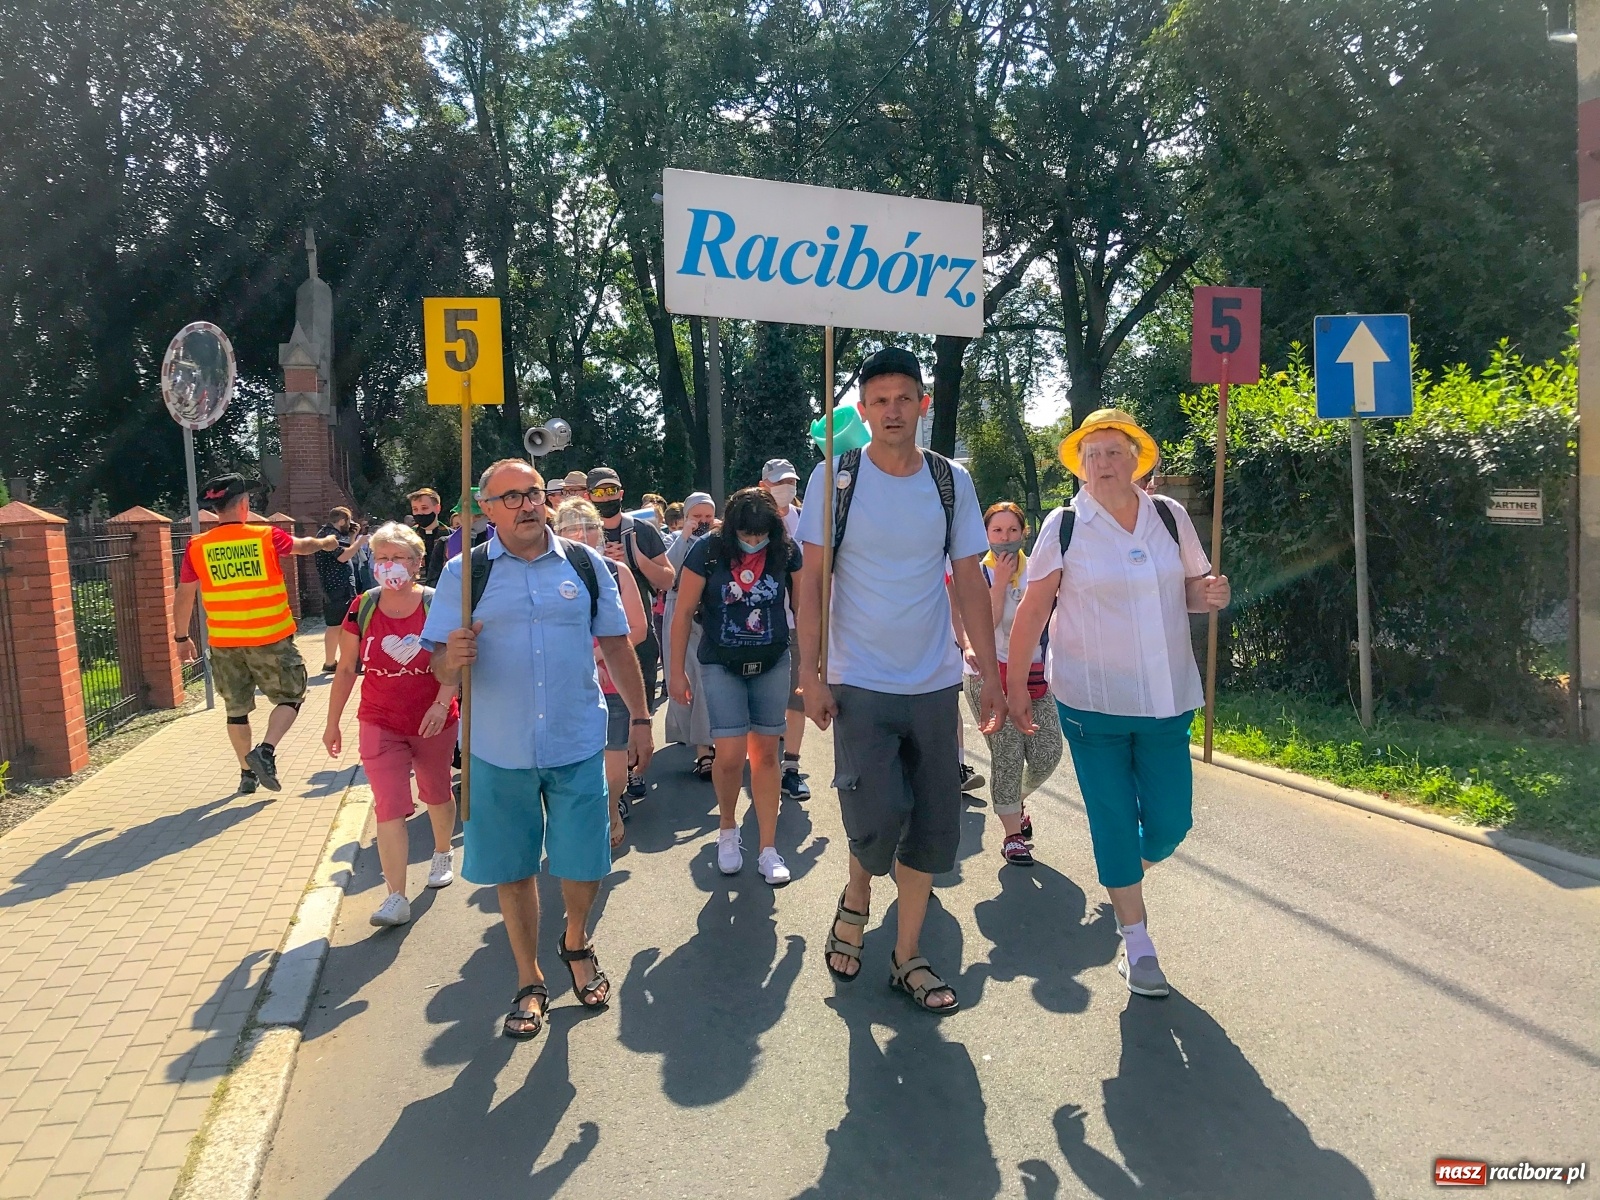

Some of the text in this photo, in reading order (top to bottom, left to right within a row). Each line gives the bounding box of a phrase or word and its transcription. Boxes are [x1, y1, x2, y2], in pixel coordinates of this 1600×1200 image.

[676, 208, 977, 308] Racibórz
[443, 308, 479, 372] 5
[1210, 297, 1242, 354] 5
[1491, 501, 1538, 510] ARTNER
[206, 543, 259, 562] KIEROWANIE
[210, 560, 262, 581] RUCHEM
